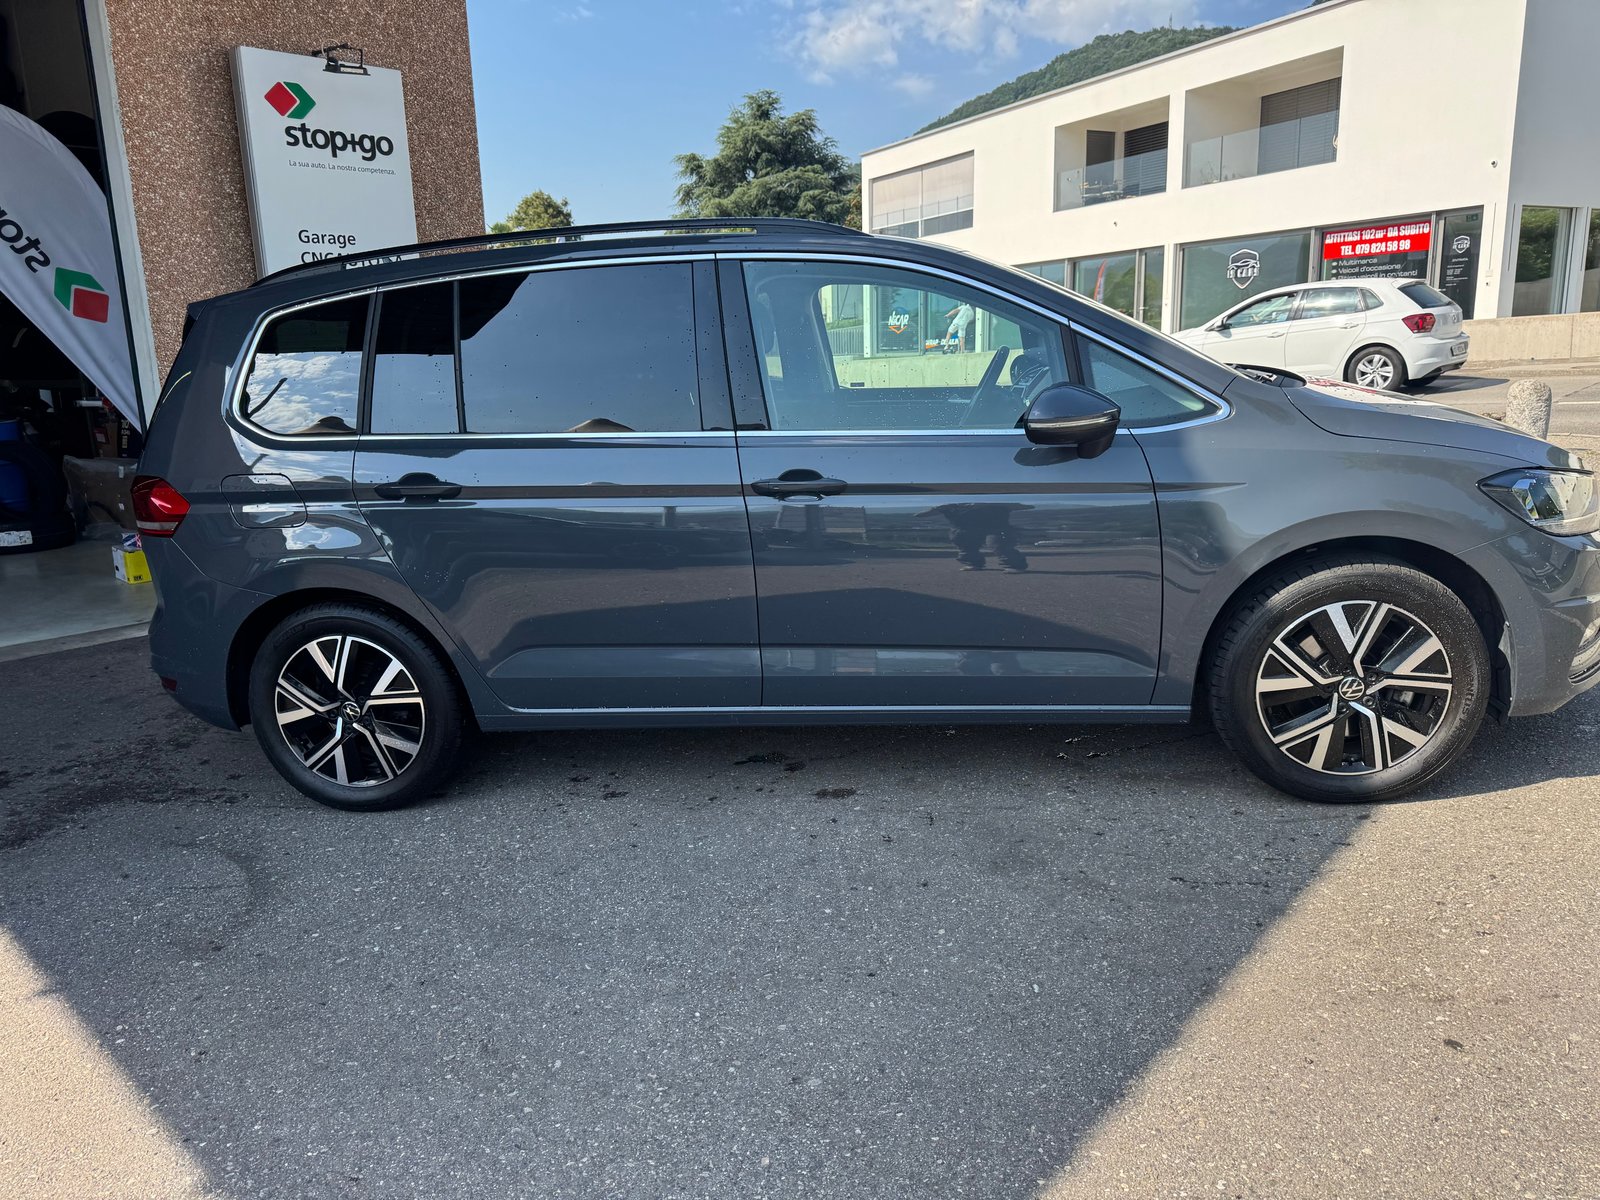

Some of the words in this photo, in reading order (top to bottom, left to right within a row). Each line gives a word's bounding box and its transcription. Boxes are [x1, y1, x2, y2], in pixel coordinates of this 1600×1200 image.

[284, 122, 394, 162] stop+go
[311, 162, 327, 170] auto.
[337, 164, 357, 172] nostra
[358, 166, 397, 176] competenza.
[298, 229, 356, 249] Garage
[1387, 226, 1398, 238] DA
[1399, 223, 1429, 236] SUBITO
[1340, 245, 1354, 256] TEL.
[1355, 243, 1370, 255] 079
[1371, 242, 1386, 253] 824
[1386, 240, 1398, 252] 58
[1399, 239, 1411, 250] 98
